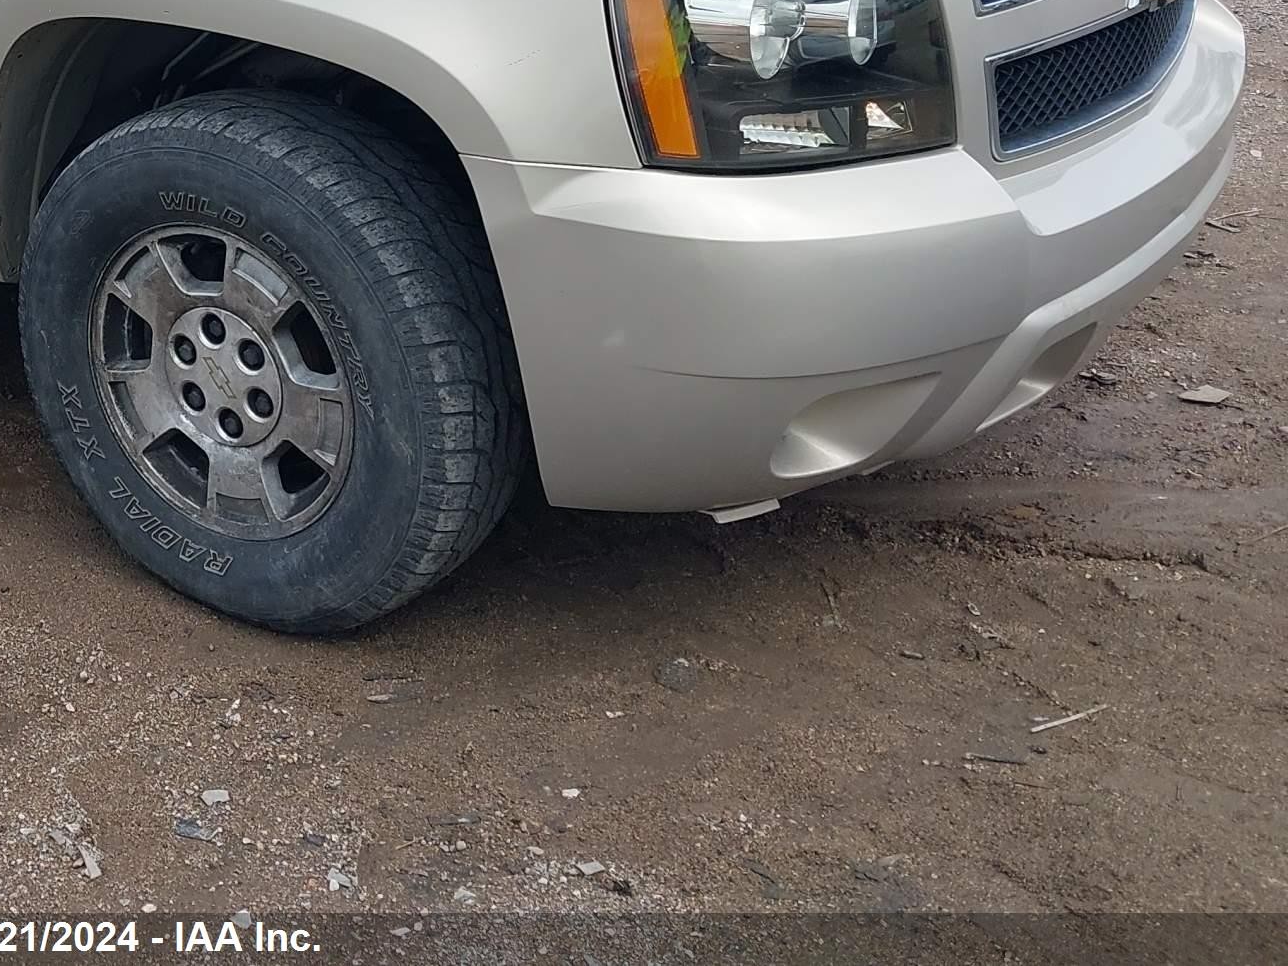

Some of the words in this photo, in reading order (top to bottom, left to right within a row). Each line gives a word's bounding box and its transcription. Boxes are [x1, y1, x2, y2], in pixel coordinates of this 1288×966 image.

[158, 190, 248, 229] WILD
[260, 230, 375, 420] COUNTRY
[56, 379, 107, 462] XTX
[108, 476, 234, 577] RADIAL
